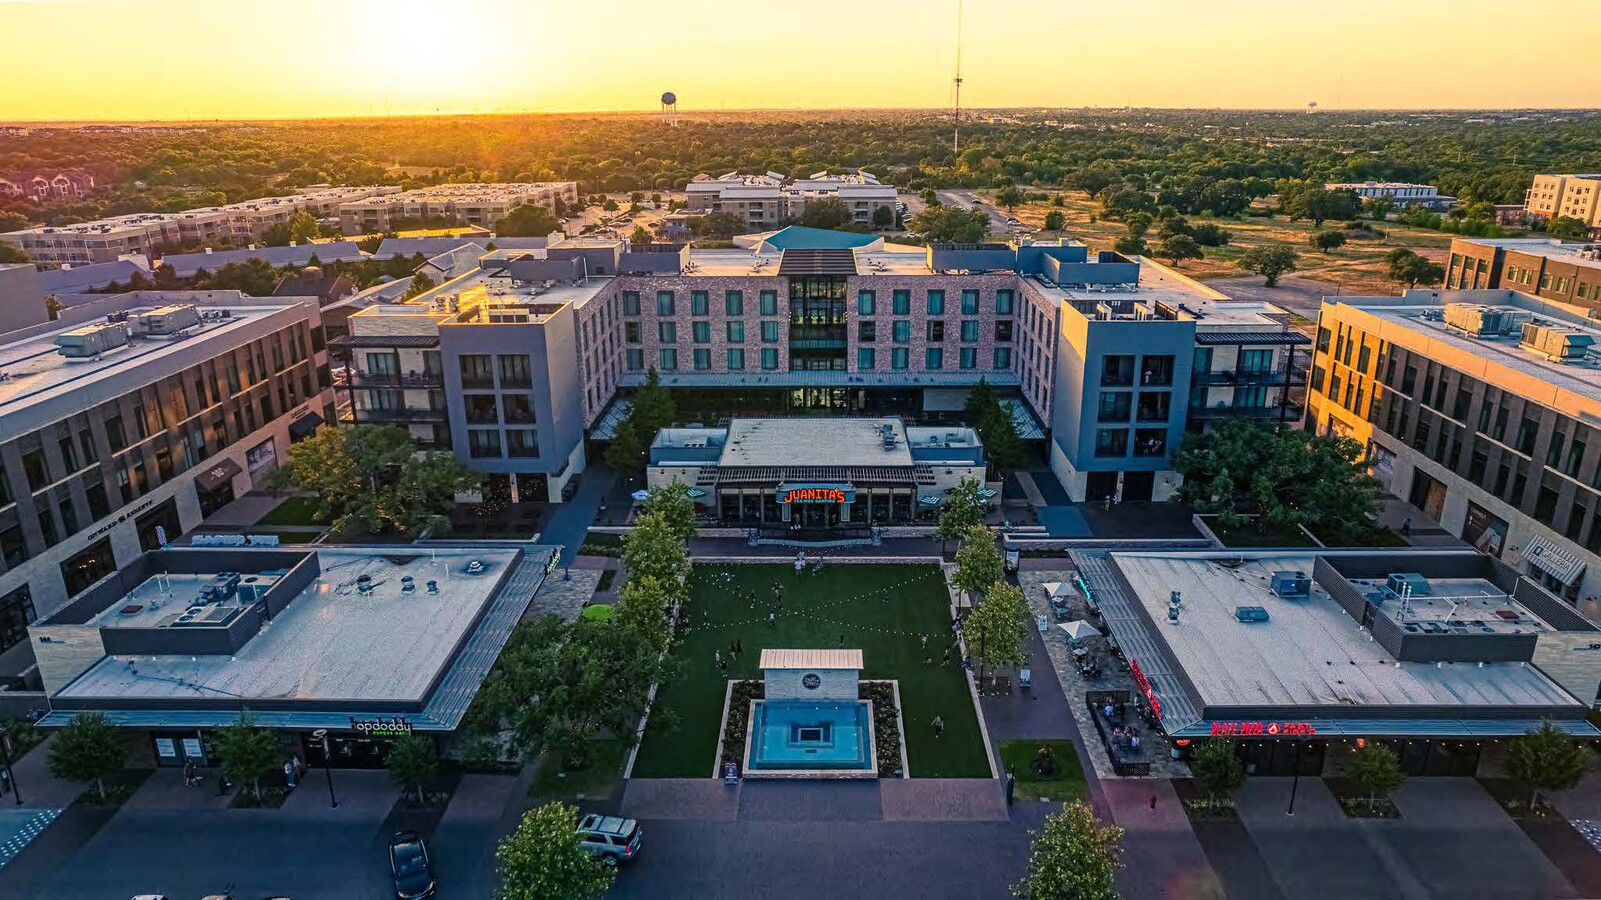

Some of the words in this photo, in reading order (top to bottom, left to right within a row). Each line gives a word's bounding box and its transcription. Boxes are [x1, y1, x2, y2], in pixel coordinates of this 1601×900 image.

[784, 488, 845, 503] JUANITA'S
[1541, 550, 1571, 571] GALLERIA
[1240, 721, 1263, 736] PIZZA
